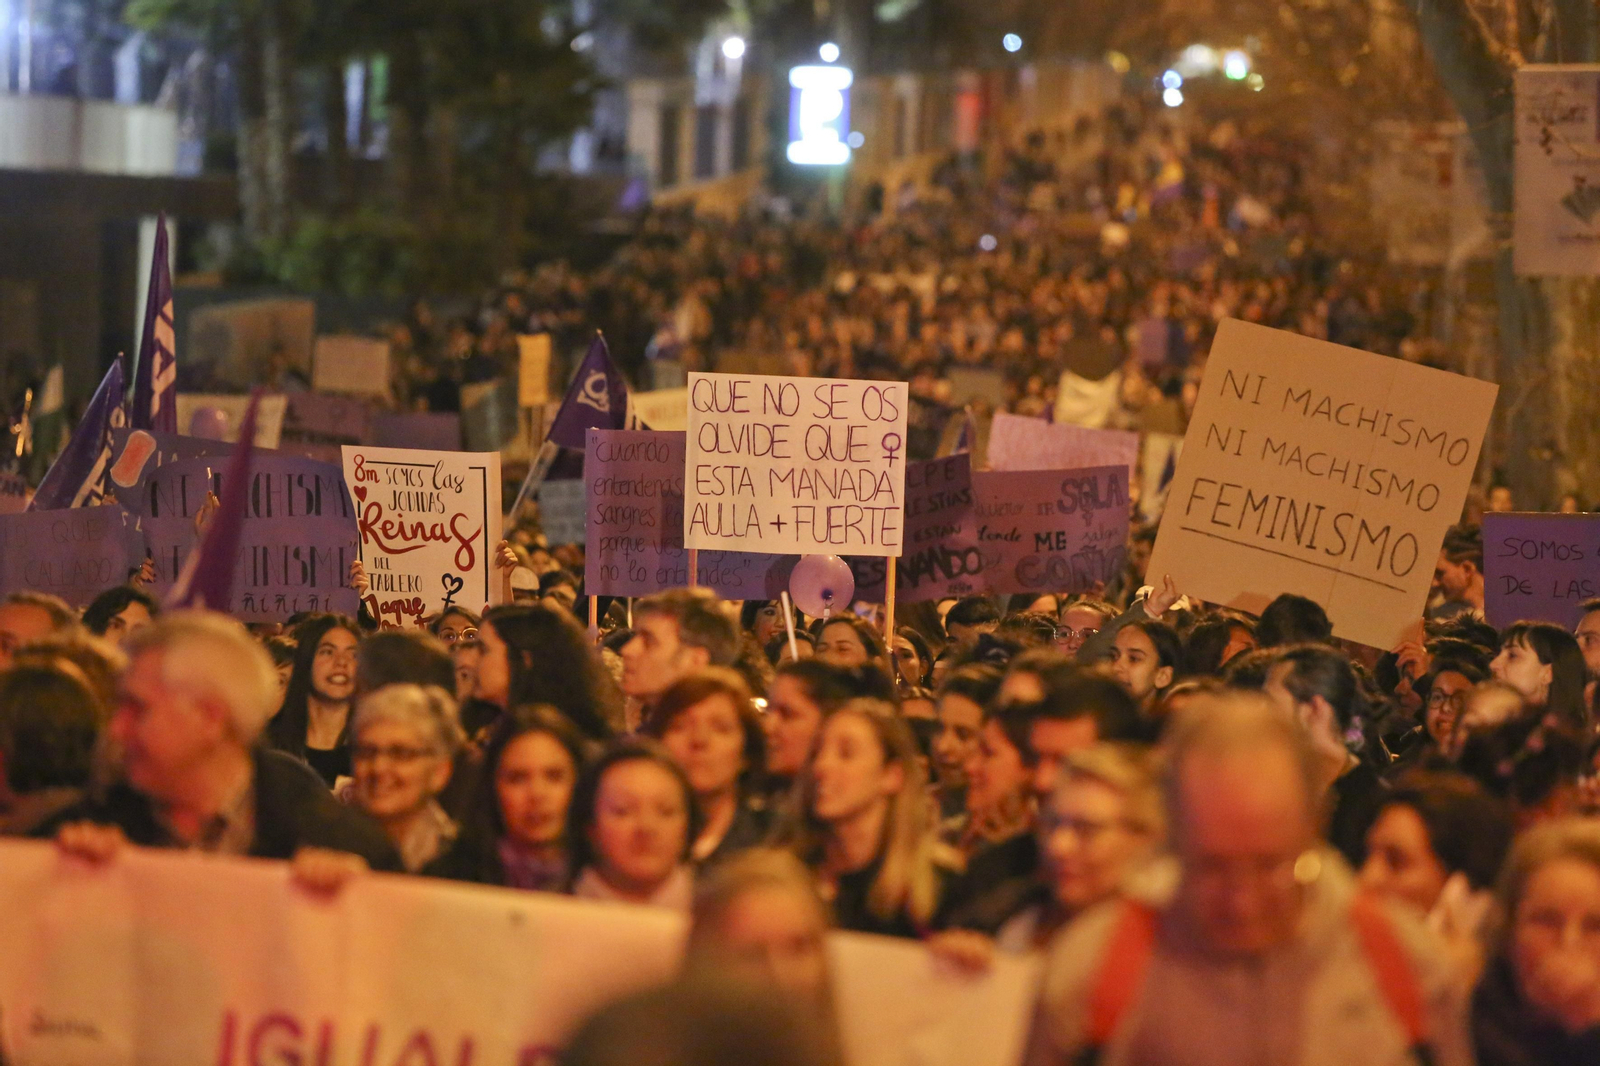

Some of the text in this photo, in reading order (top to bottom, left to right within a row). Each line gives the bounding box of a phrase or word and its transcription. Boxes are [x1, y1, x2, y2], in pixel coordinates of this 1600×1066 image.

[692, 378, 751, 413] QUE
[763, 383, 800, 416] NO
[813, 384, 849, 420] SE
[862, 385, 899, 422] OS
[1220, 369, 1470, 467] NI MACHISMO
[699, 422, 871, 463] OLVIDE QUE
[386, 467, 424, 487] SOMOS
[432, 459, 465, 493] las
[696, 465, 895, 504] ESTA MANADA
[1204, 422, 1441, 513] NI MACHISMO
[151, 472, 189, 518] NI
[388, 490, 446, 514] JODIDAS
[1057, 473, 1125, 519] SOLA
[51, 519, 102, 543] QUE
[359, 501, 483, 572] Reinas
[689, 503, 900, 547] AULLA + FUERTE
[1034, 531, 1067, 553] ME
[1185, 477, 1419, 578] FEMINISMO
[374, 557, 391, 570] DEL
[598, 536, 645, 562] porque
[1497, 537, 1584, 561] SOMOS
[24, 558, 112, 587] CALLADO
[367, 572, 423, 593] TABLERO
[599, 563, 619, 582] no
[1499, 575, 1596, 600] DE LAS
[364, 593, 427, 630] Jaque
